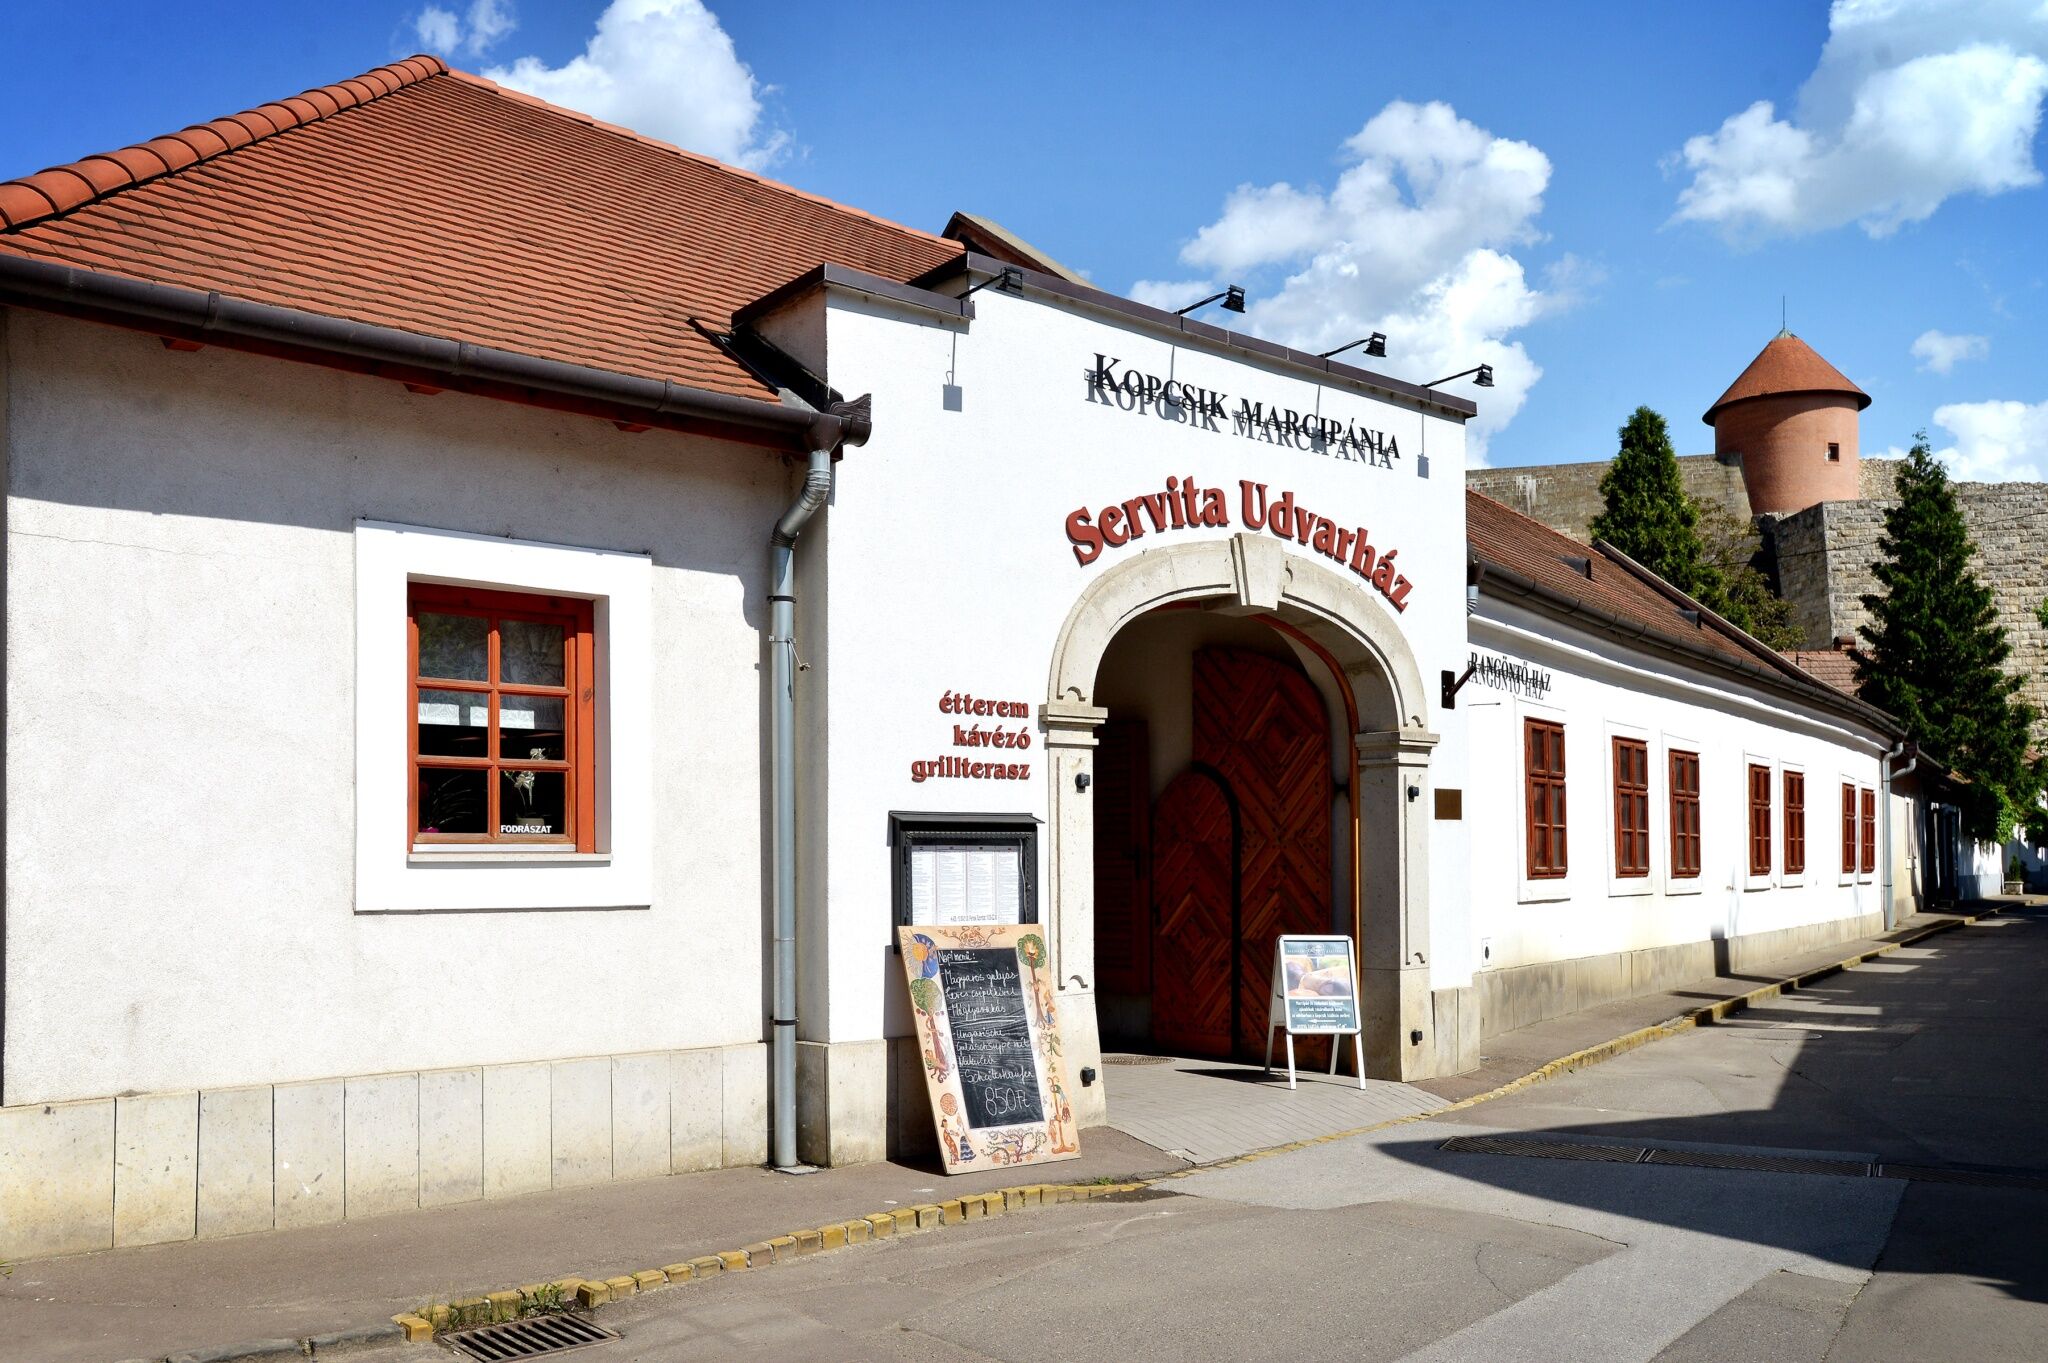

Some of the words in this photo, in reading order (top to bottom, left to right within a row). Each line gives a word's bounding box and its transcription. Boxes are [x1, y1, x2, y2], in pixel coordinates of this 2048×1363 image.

[1093, 352, 1229, 420] KOPCSIK
[1240, 397, 1400, 459] MARCIPÁNIA
[1065, 475, 1230, 568] Servita
[1239, 479, 1415, 615] Udvarház
[939, 690, 1029, 718] étterem
[953, 723, 1031, 750] kávézó
[911, 755, 1031, 783] grillterasz
[500, 823, 552, 834] FODRÁSZAT
